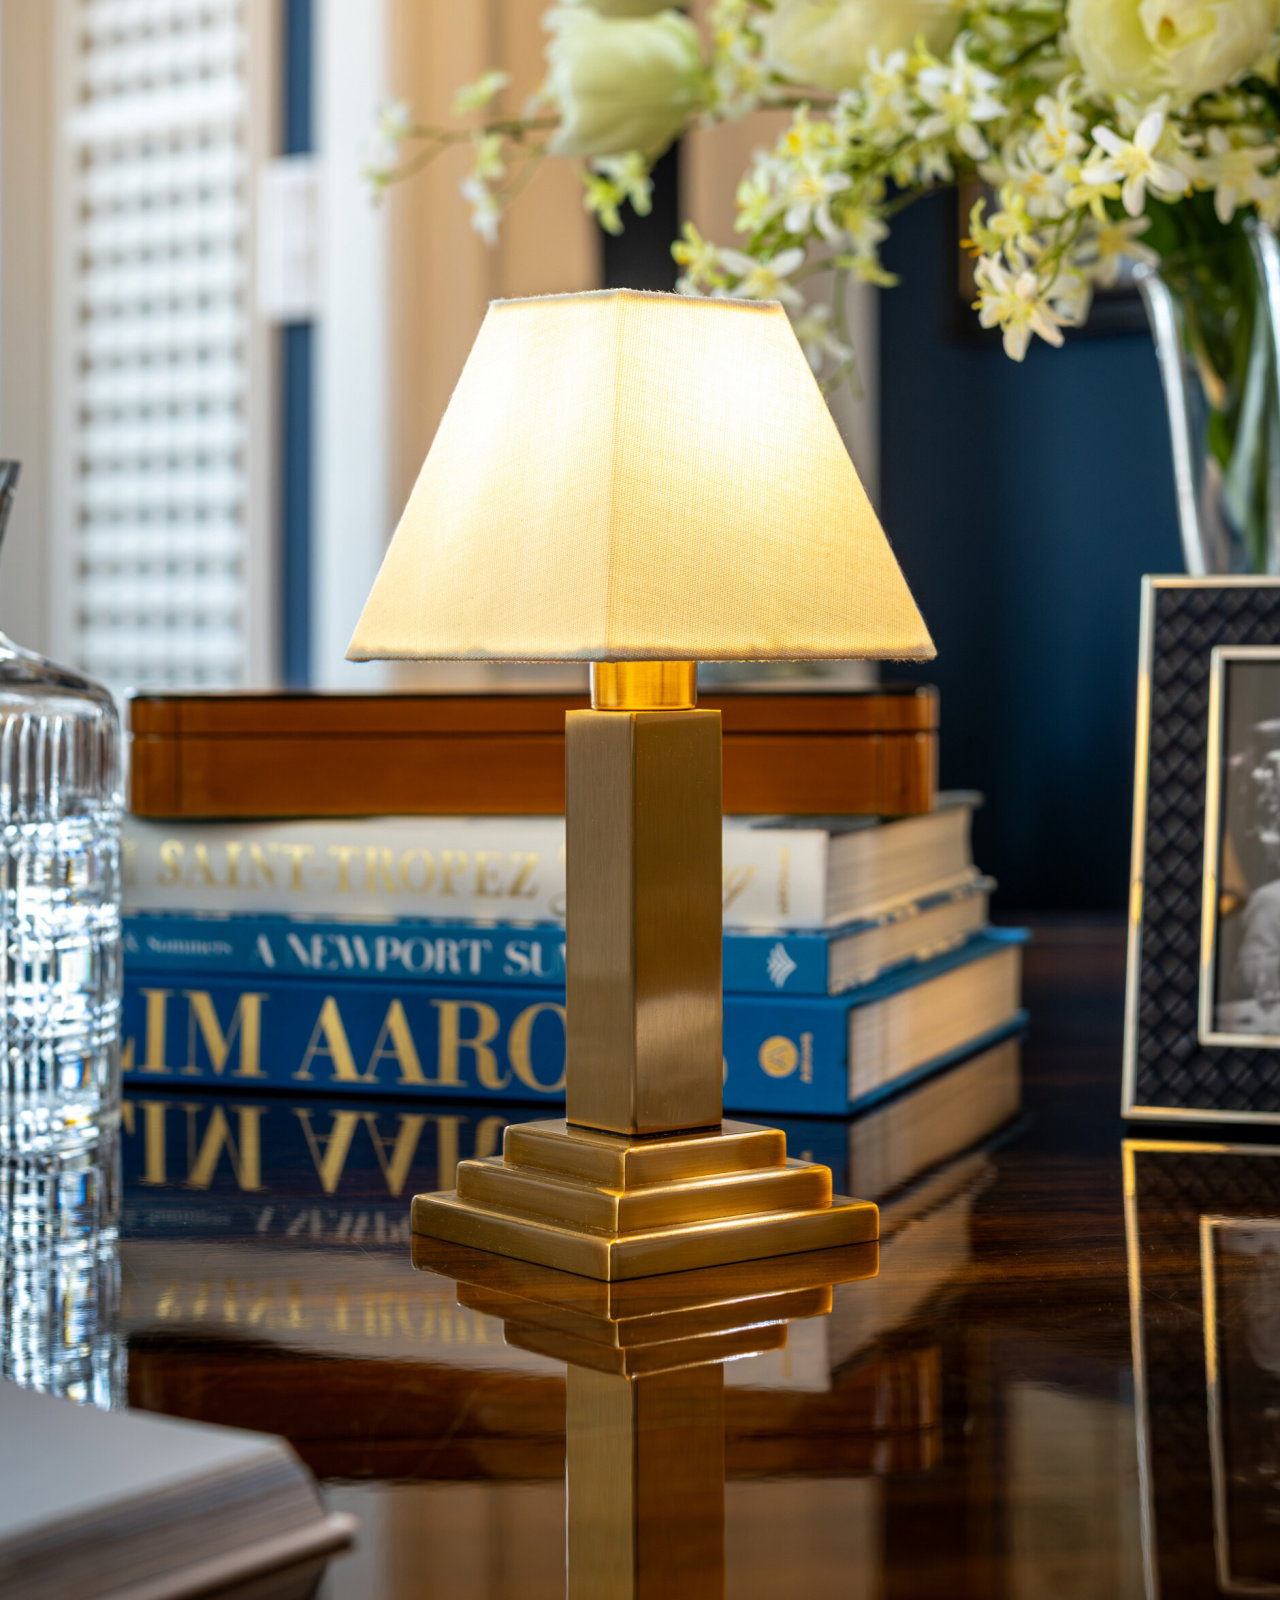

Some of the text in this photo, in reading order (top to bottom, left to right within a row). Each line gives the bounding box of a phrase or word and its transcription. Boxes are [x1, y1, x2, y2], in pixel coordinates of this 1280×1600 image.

[155, 838, 540, 898] SAINT-TROPEZ
[253, 932, 566, 978] A NEWPORT SU
[290, 995, 566, 1093] AARO
